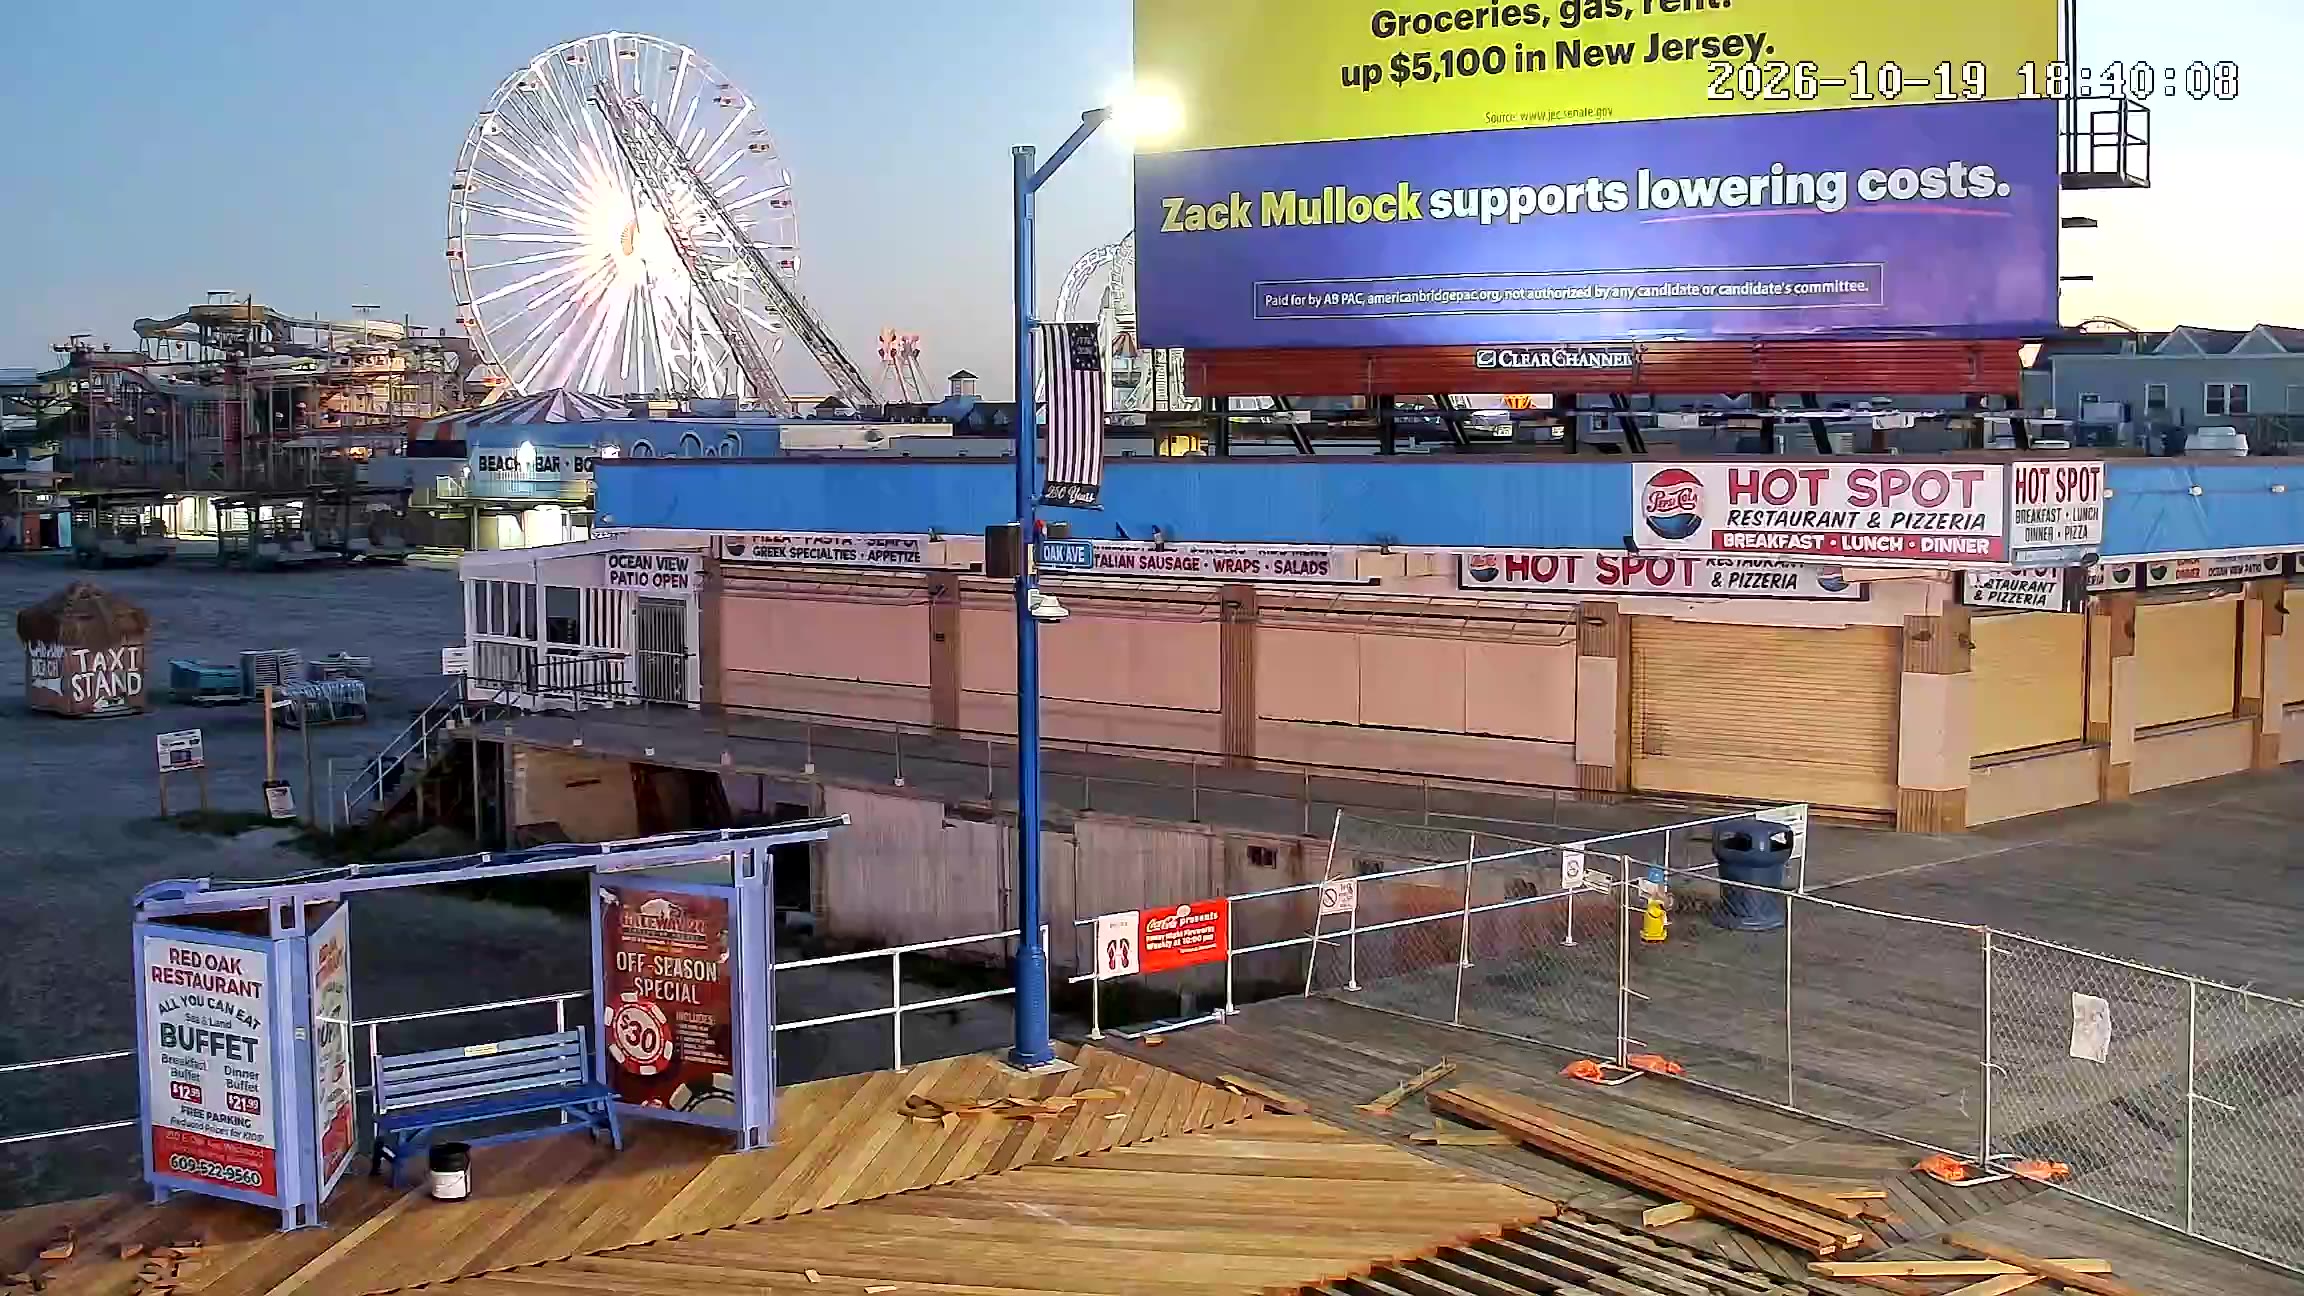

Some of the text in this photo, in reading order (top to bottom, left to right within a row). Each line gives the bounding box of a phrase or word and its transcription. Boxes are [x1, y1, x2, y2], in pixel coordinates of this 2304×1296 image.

[1371, 0, 1551, 39] Groceries,
[1559, 0, 1635, 28] gas,
[1341, 32, 1775, 92] up $5,100 in New Jersey.
[1160, 160, 2011, 233] Zack Mullock supports lowering costs.
[1265, 293, 1289, 307] Paid
[1290, 293, 1306, 306] for
[1308, 293, 1321, 308] by
[1324, 293, 1339, 305] AB
[1341, 293, 1365, 307] PAC,
[1505, 287, 1524, 300] not
[1526, 284, 1592, 300] authorized
[1594, 283, 1611, 300] by
[1612, 286, 1633, 301] any
[1636, 281, 1699, 297] candidate
[1702, 284, 1717, 296] or
[1718, 280, 1792, 296] candidate's
[1794, 279, 1869, 294] committee.
[536, 456, 560, 472] BAR
[1728, 468, 1984, 508] HOT SPOT
[2015, 467, 2101, 505] HOT SPOT
[1727, 510, 1986, 531] RESTAURANT & PIZZERIA
[2015, 507, 2099, 525] BREAKFAST LUNCH
[1723, 532, 1990, 555] BREAKFAST LUNCH DINNER
[2025, 525, 2088, 543] DINNER PIZZA
[608, 554, 689, 571] OCEAN VIEW
[752, 546, 921, 563] GREEK SPECIALTIES APPETIZE
[1043, 546, 1064, 561] OAK
[1066, 547, 1085, 562] AVE
[1139, 555, 1200, 571] SAUSAGE
[1213, 557, 1260, 573] WRAPS
[1274, 559, 1328, 575] SALADS
[610, 571, 689, 589] PATIO OPEN
[1505, 552, 1700, 586] HOT SPOT
[1711, 571, 1799, 590] & PIZZERIA
[1973, 590, 2047, 607] & PIZZERIA
[71, 647, 139, 673] TAXI
[71, 670, 142, 703] STAND
[169, 947, 243, 975] RED OAK
[151, 965, 263, 999] RESTAURANT
[634, 976, 701, 1005] SPECIAL
[159, 994, 261, 1030] ALL YOU CAN EAT
[159, 1022, 259, 1064] BUFFET
[620, 1013, 657, 1054] $30
[170, 1067, 201, 1082] Buffet
[224, 1065, 260, 1081] Dinner
[226, 1079, 260, 1094] Buffet
[180, 1104, 252, 1129] FREE PARKING
[170, 1154, 262, 1186] 609-522-9560
